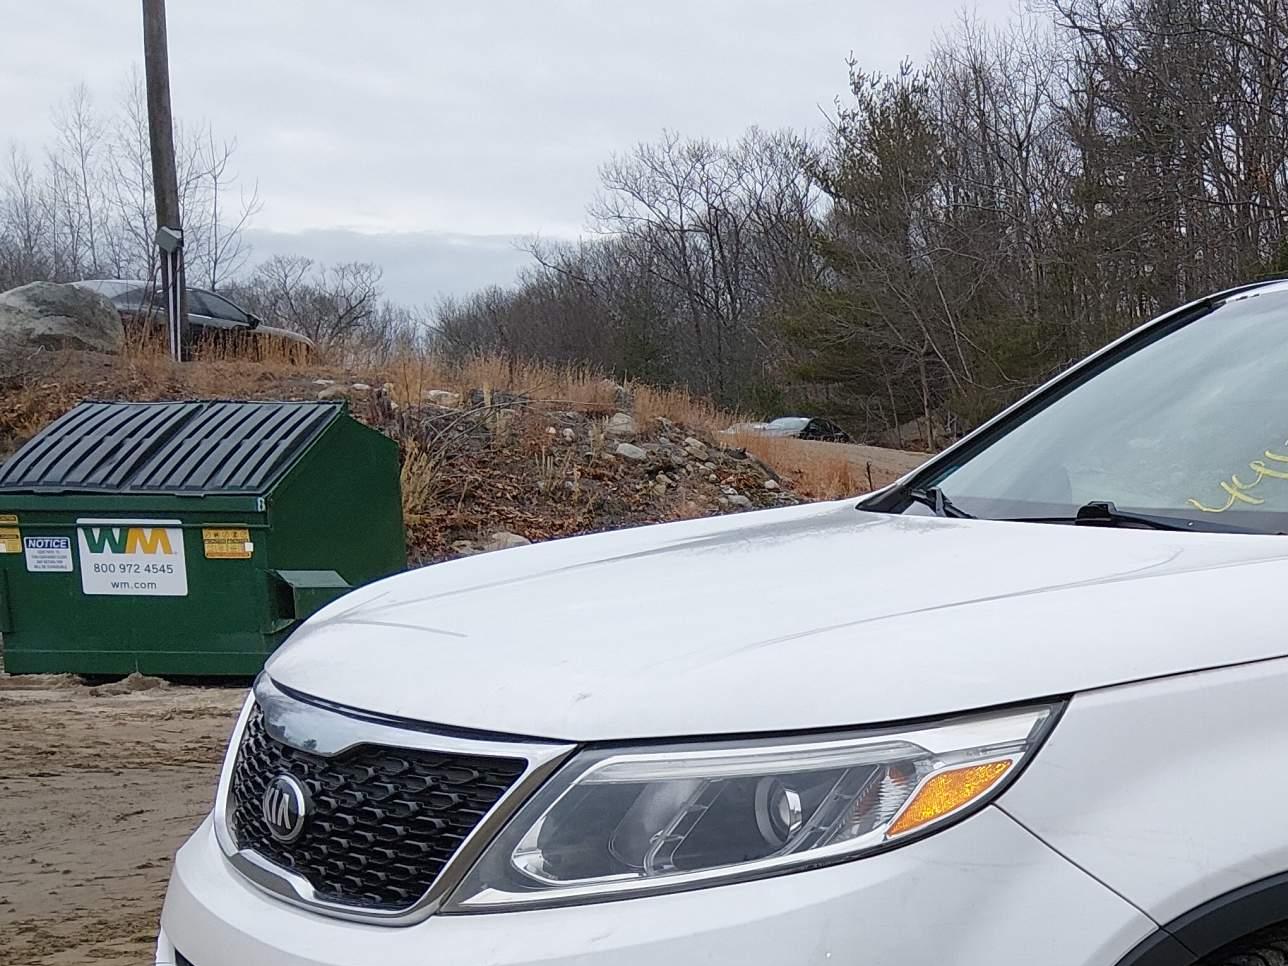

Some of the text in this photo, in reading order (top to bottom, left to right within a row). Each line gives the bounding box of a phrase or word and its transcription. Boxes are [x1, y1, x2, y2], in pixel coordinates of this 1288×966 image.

[28, 539, 67, 548] NOTICE
[81, 527, 173, 555] WM
[93, 563, 174, 574] 800 972 4545
[111, 580, 157, 590] wm.com
